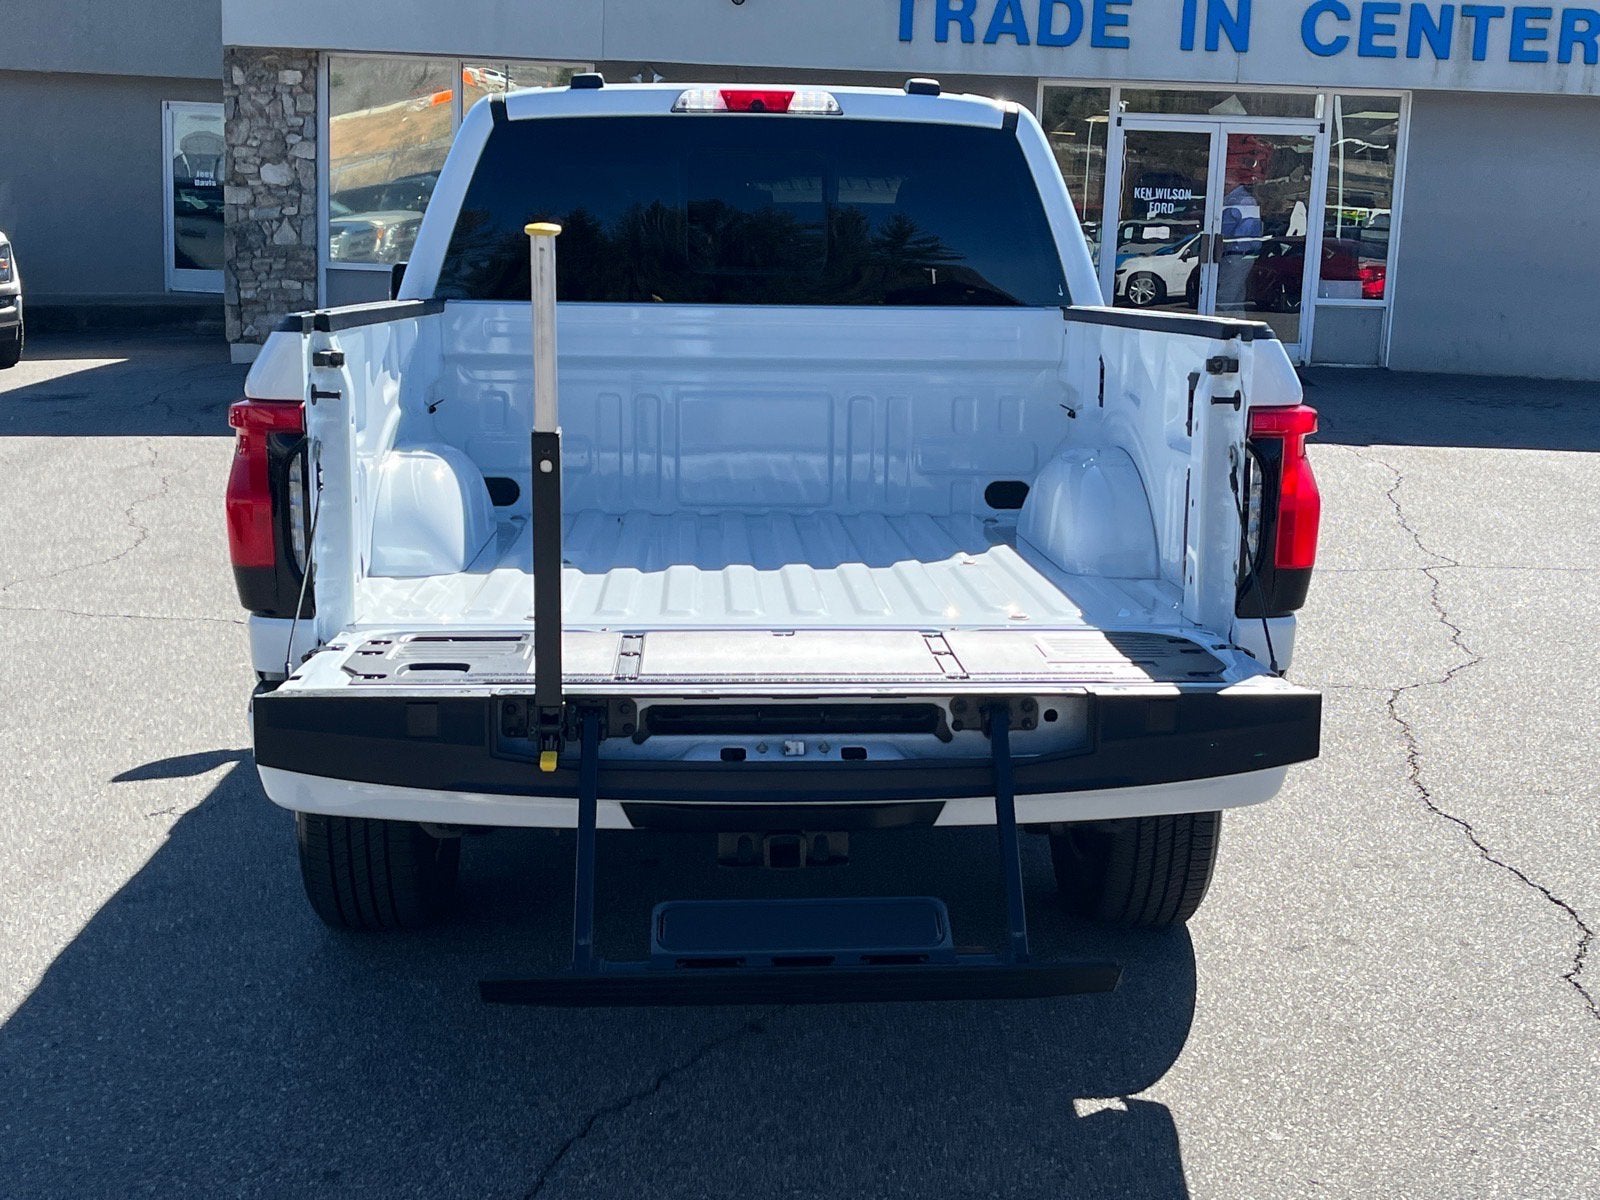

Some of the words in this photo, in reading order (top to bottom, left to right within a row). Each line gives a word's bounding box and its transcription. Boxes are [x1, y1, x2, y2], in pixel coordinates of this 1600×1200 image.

[897, 0, 1133, 49] TRADE
[1180, 0, 1252, 53] IN
[1300, 0, 1600, 65] CENTER
[1134, 187, 1153, 199] KEN
[1155, 187, 1192, 200] WILSON
[1149, 201, 1175, 214] FORD
